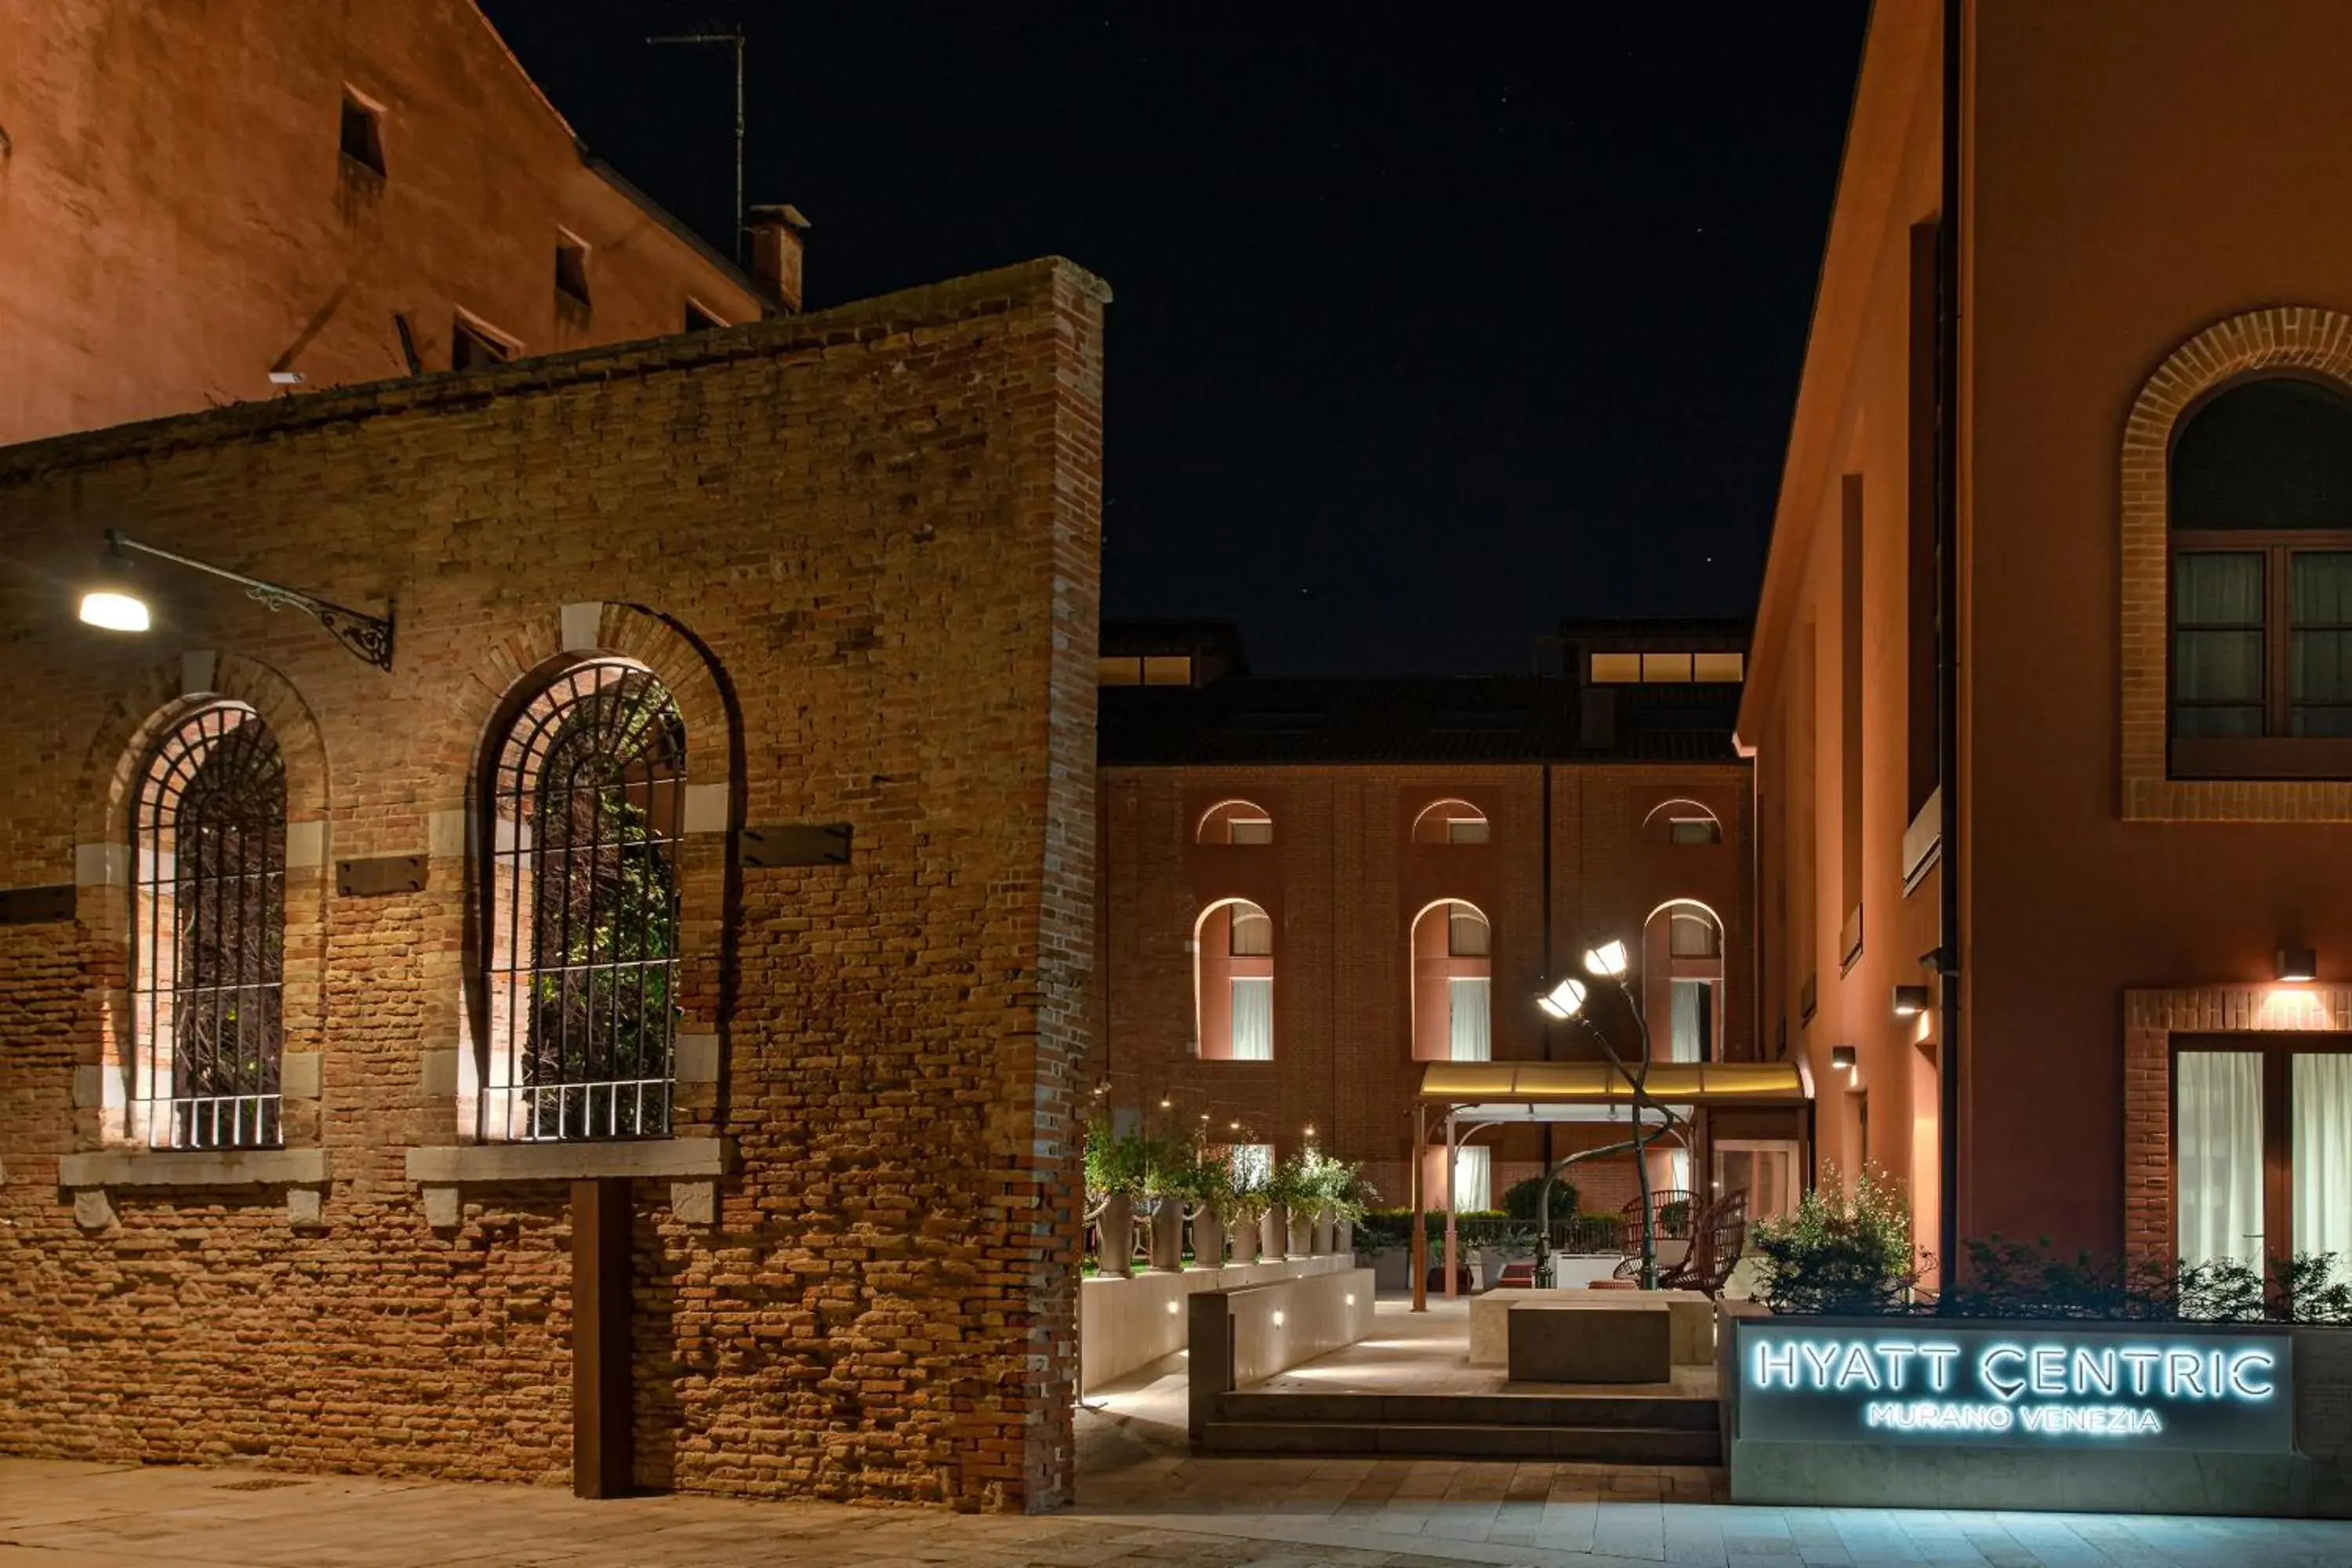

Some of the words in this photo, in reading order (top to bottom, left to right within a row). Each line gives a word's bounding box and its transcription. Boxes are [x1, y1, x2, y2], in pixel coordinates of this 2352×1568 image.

[1756, 1342, 1959, 1388] HYATT
[1981, 1346, 2274, 1399] CENTRIC
[1869, 1404, 2011, 1429] MURANO
[2021, 1406, 2163, 1434] VENEZIA
